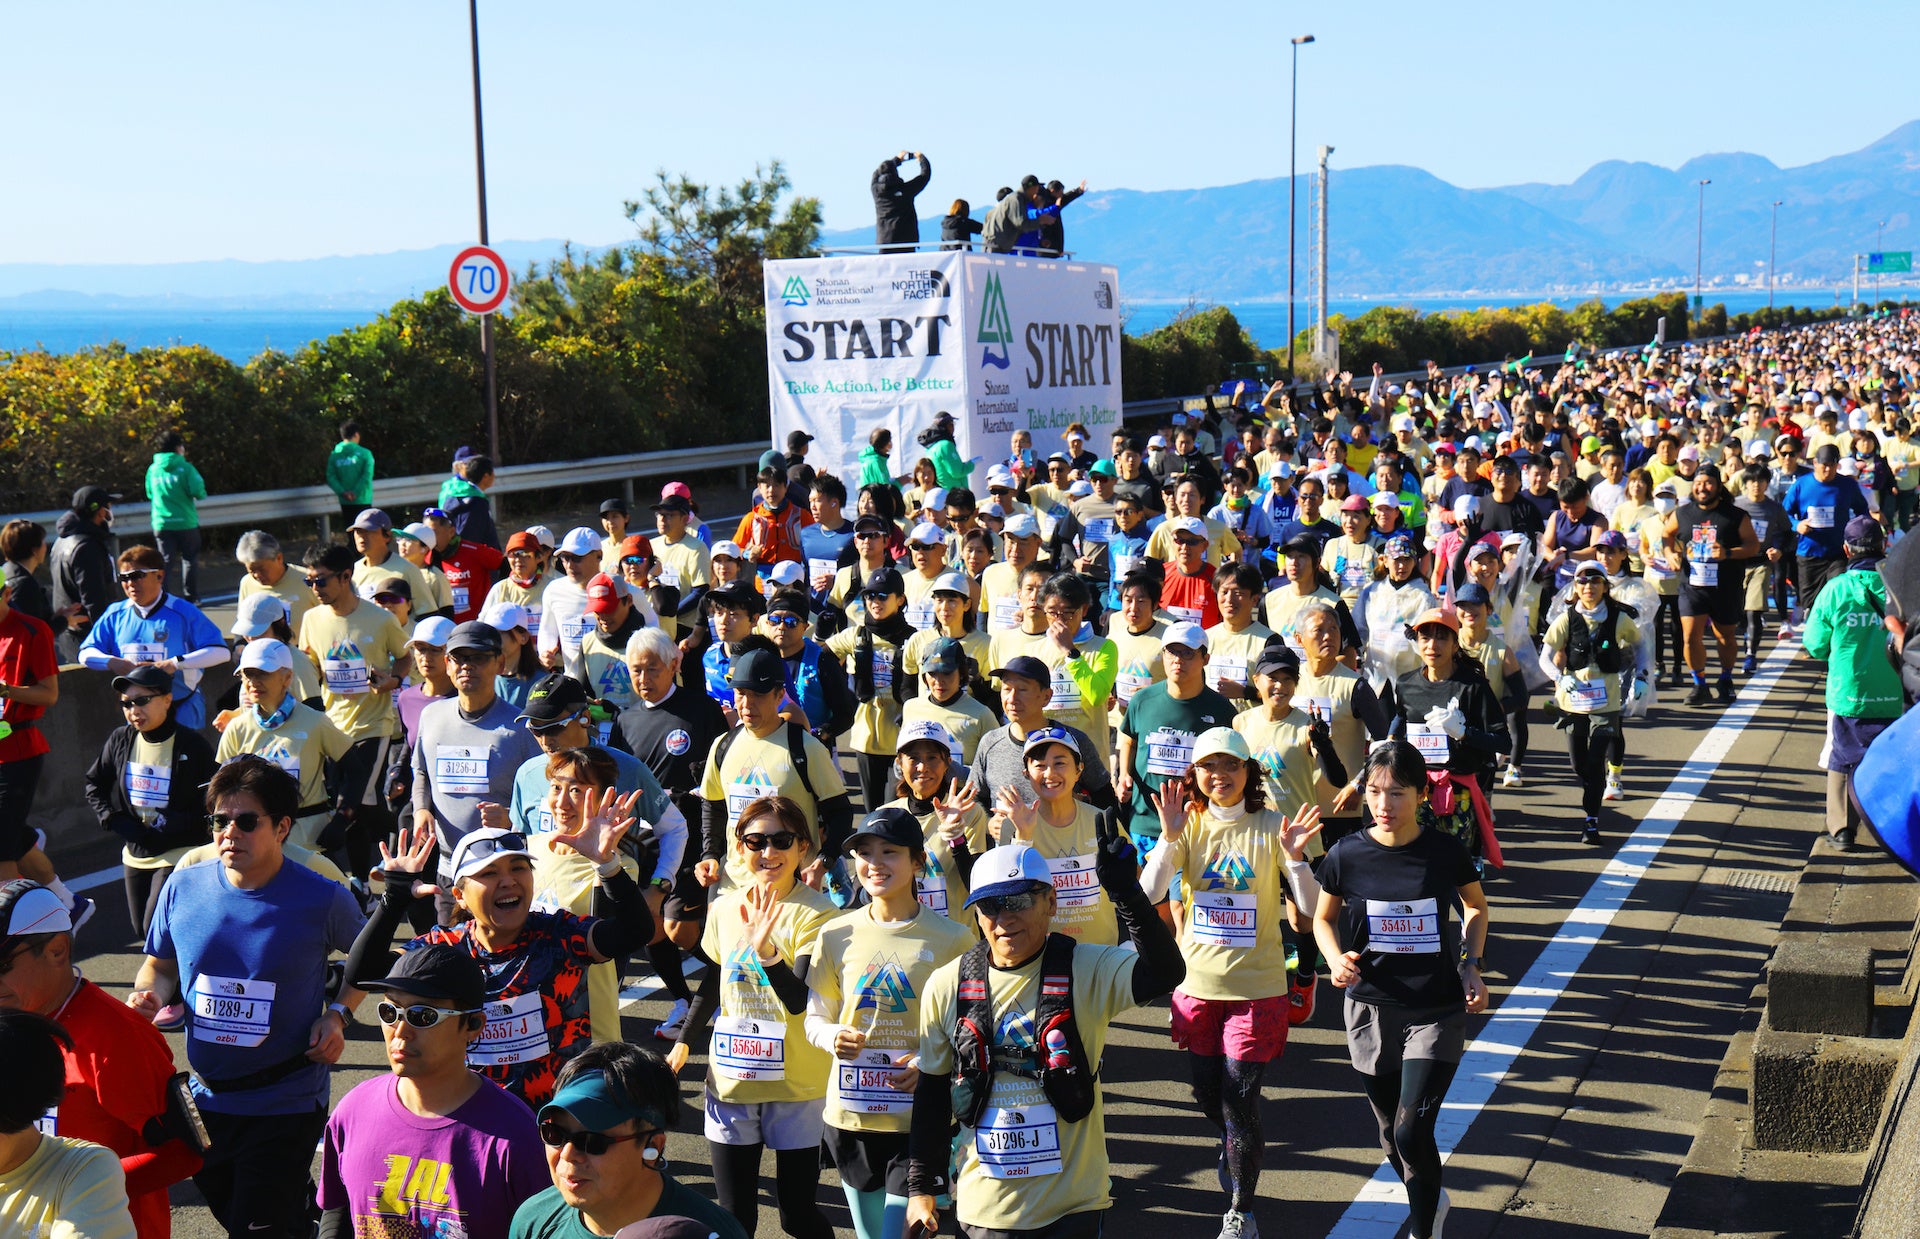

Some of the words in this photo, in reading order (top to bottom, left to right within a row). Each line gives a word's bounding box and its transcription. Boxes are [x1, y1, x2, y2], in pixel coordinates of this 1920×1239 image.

[462, 266, 495, 294] 70
[908, 270, 930, 280] THE
[816, 278, 850, 287] Shonan
[892, 281, 931, 290] NORTH
[816, 286, 874, 296] International
[903, 290, 931, 299] FACE
[816, 298, 861, 306] Marathon
[782, 314, 952, 362] START
[1025, 322, 1113, 389] START
[784, 381, 819, 395] Take
[823, 380, 878, 394] Action,
[881, 378, 901, 391] Be
[906, 377, 955, 391] Better
[984, 379, 1010, 396] Shonan
[976, 398, 1019, 415] International
[1026, 408, 1048, 430] Take
[1080, 406, 1090, 425] Be
[1092, 404, 1117, 425] Better
[982, 417, 1015, 434] Marathon
[1275, 507, 1289, 517] bil
[1846, 612, 1880, 627] STA
[446, 761, 477, 774] 31256-J
[1053, 872, 1090, 889] 35414-J
[1056, 906, 1100, 916] ernational
[1209, 910, 1246, 925] 35470-J
[1381, 918, 1423, 932] 35431-J
[205, 998, 255, 1019] 31289-J
[215, 1034, 238, 1043] azbil
[865, 1037, 907, 1046] arathon
[732, 1038, 773, 1057] 35650-J
[497, 1053, 520, 1063] azbil
[992, 1080, 1037, 1092] honan
[867, 1104, 889, 1112] azbil
[989, 1129, 1040, 1150] 31296-J
[1006, 1166, 1029, 1176] azbil
